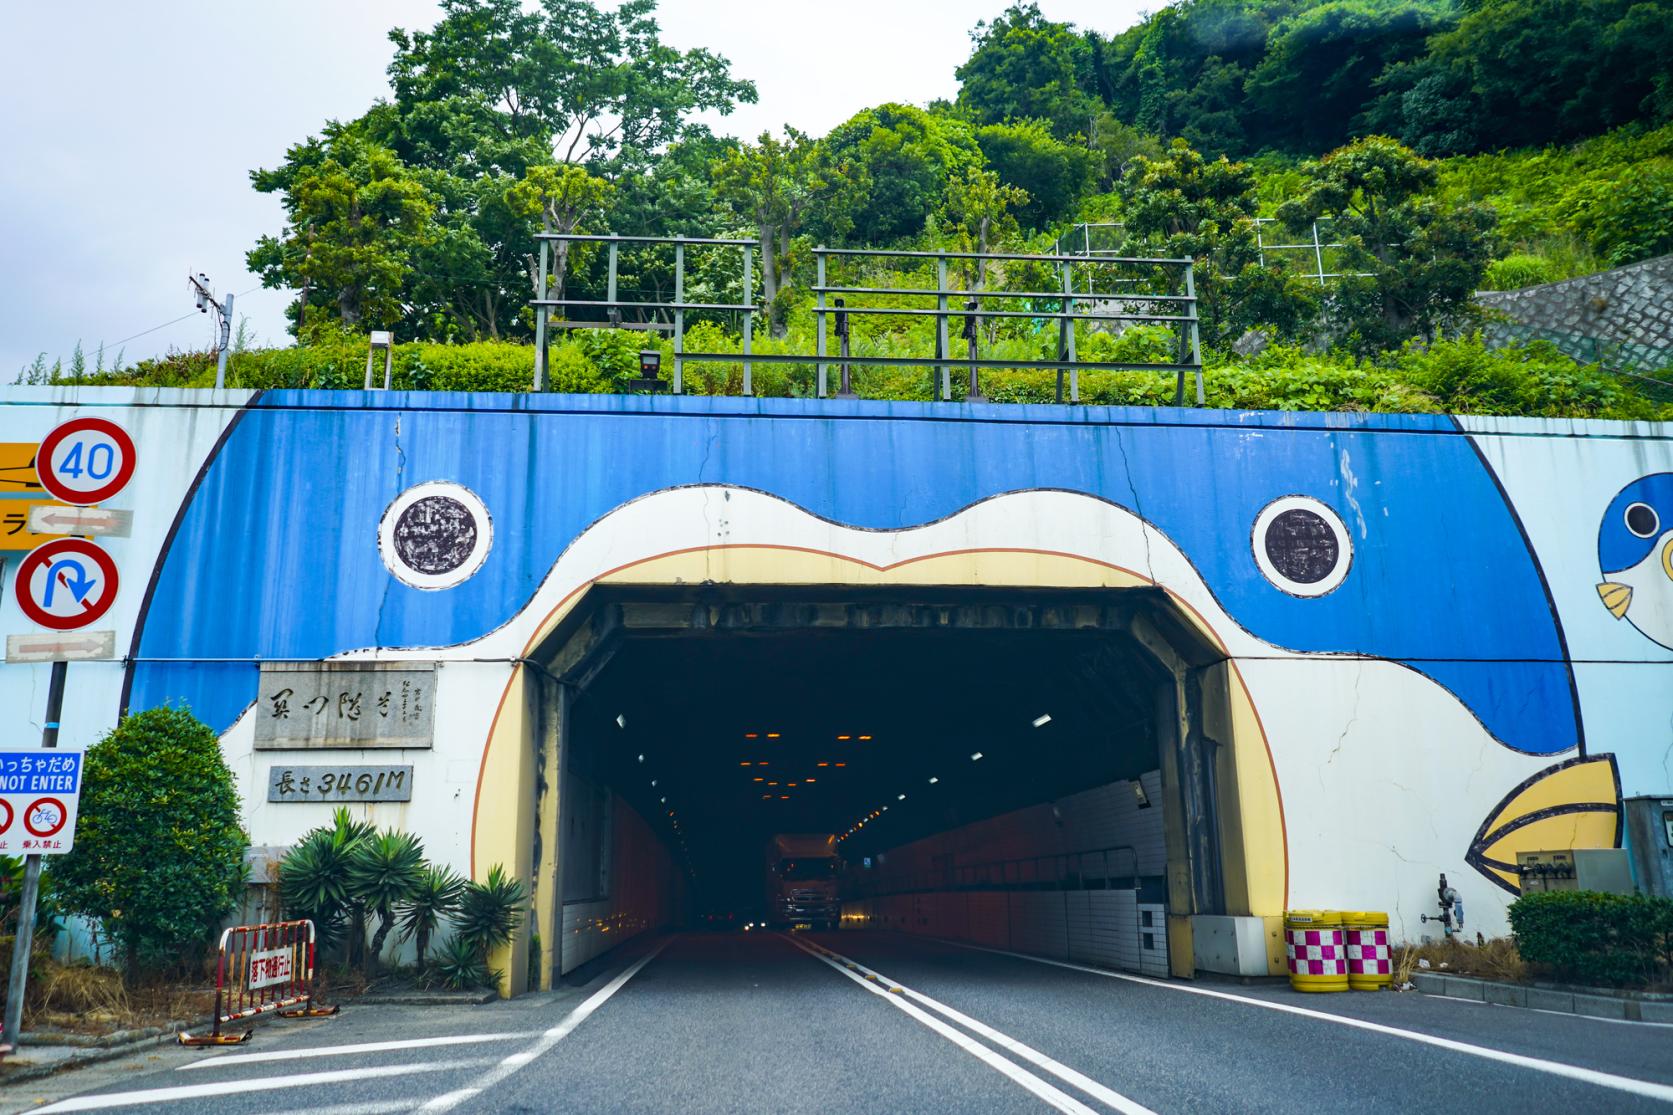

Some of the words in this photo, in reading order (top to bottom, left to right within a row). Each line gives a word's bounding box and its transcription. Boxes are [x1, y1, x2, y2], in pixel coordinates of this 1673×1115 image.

[59, 441, 114, 480] 40
[0, 775, 27, 790] NOT
[31, 775, 73, 790] ENTER
[22, 839, 62, 849] 乗入禁止
